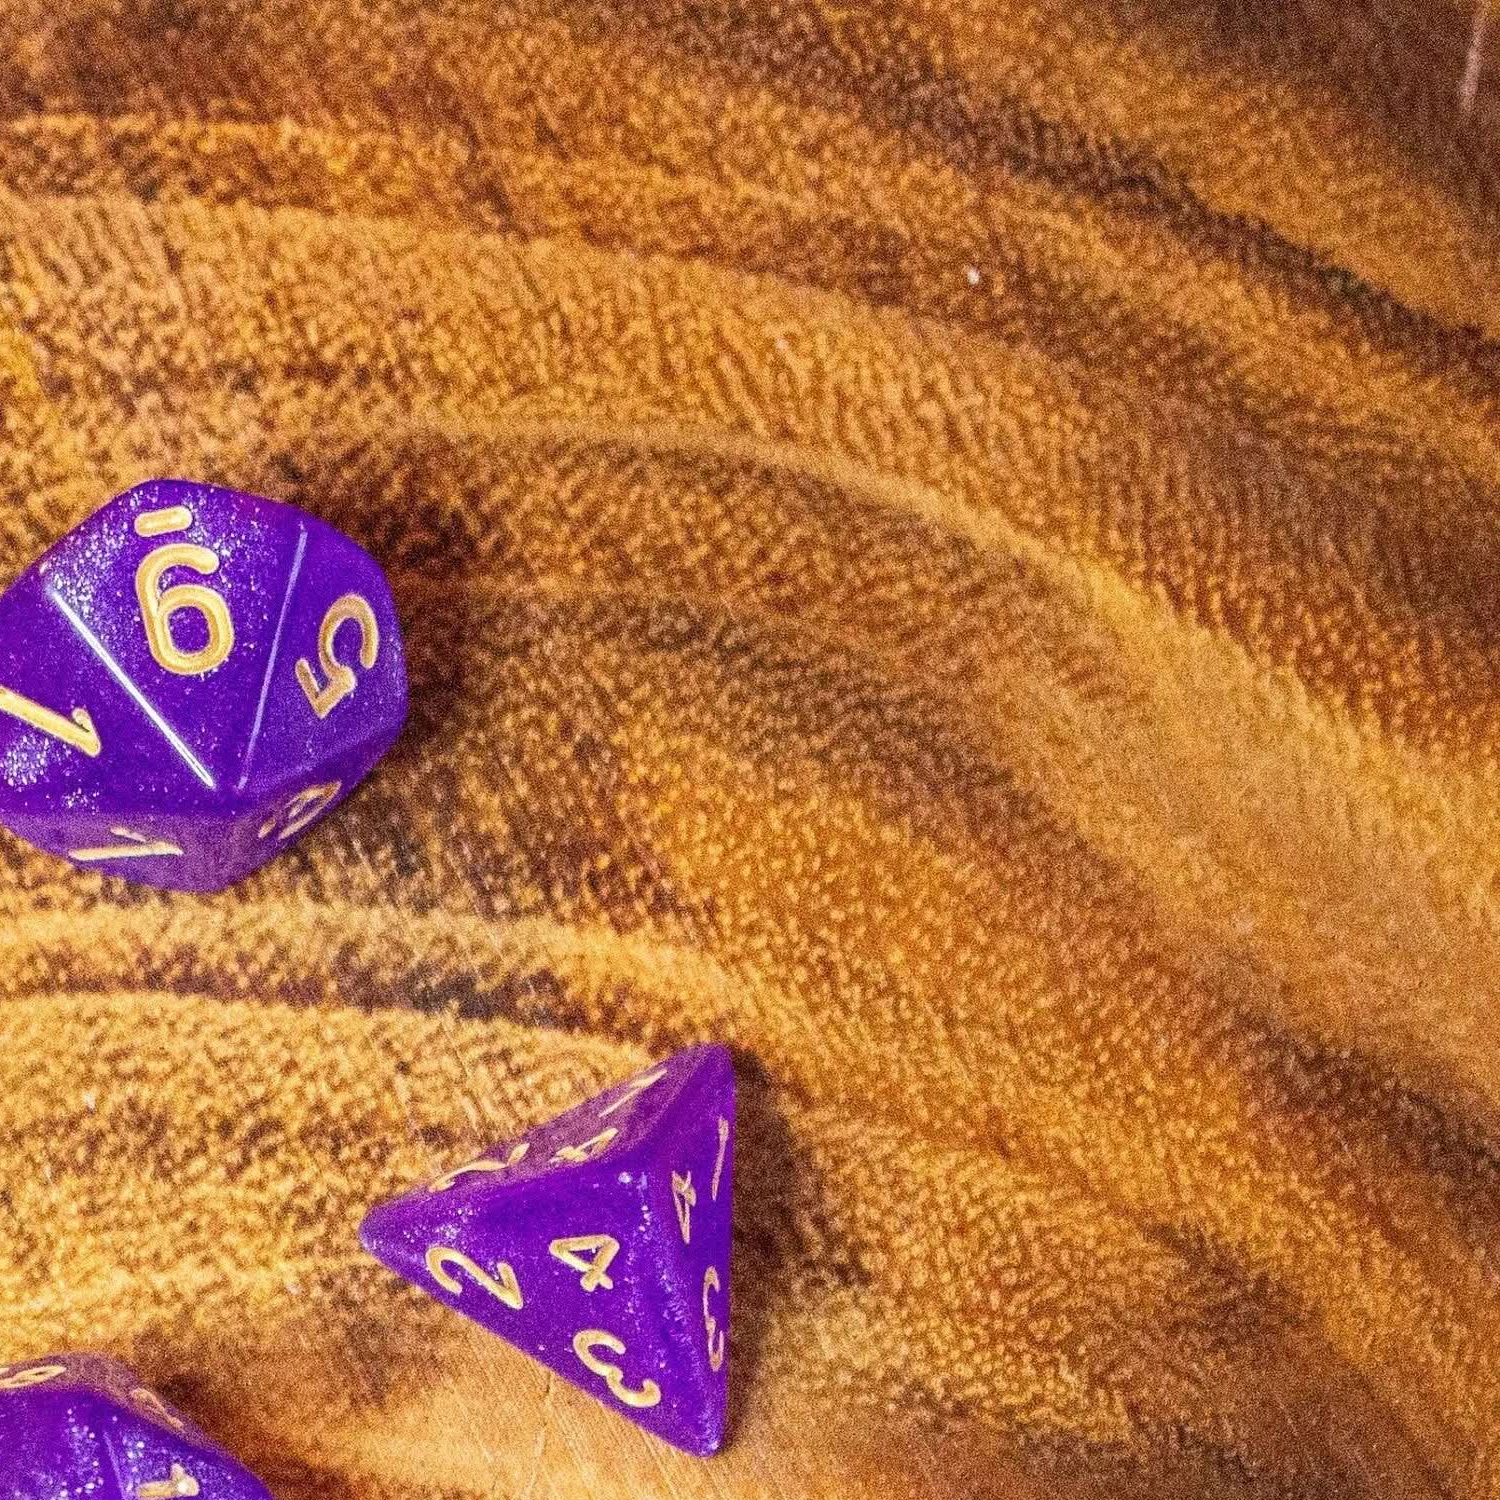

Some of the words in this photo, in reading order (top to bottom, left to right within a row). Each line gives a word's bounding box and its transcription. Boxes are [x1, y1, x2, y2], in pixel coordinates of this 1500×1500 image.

[294, 592, 380, 719] 5
[425, 1246, 524, 1309] 2
[549, 1235, 620, 1291] 4
[573, 1329, 661, 1407] 3
